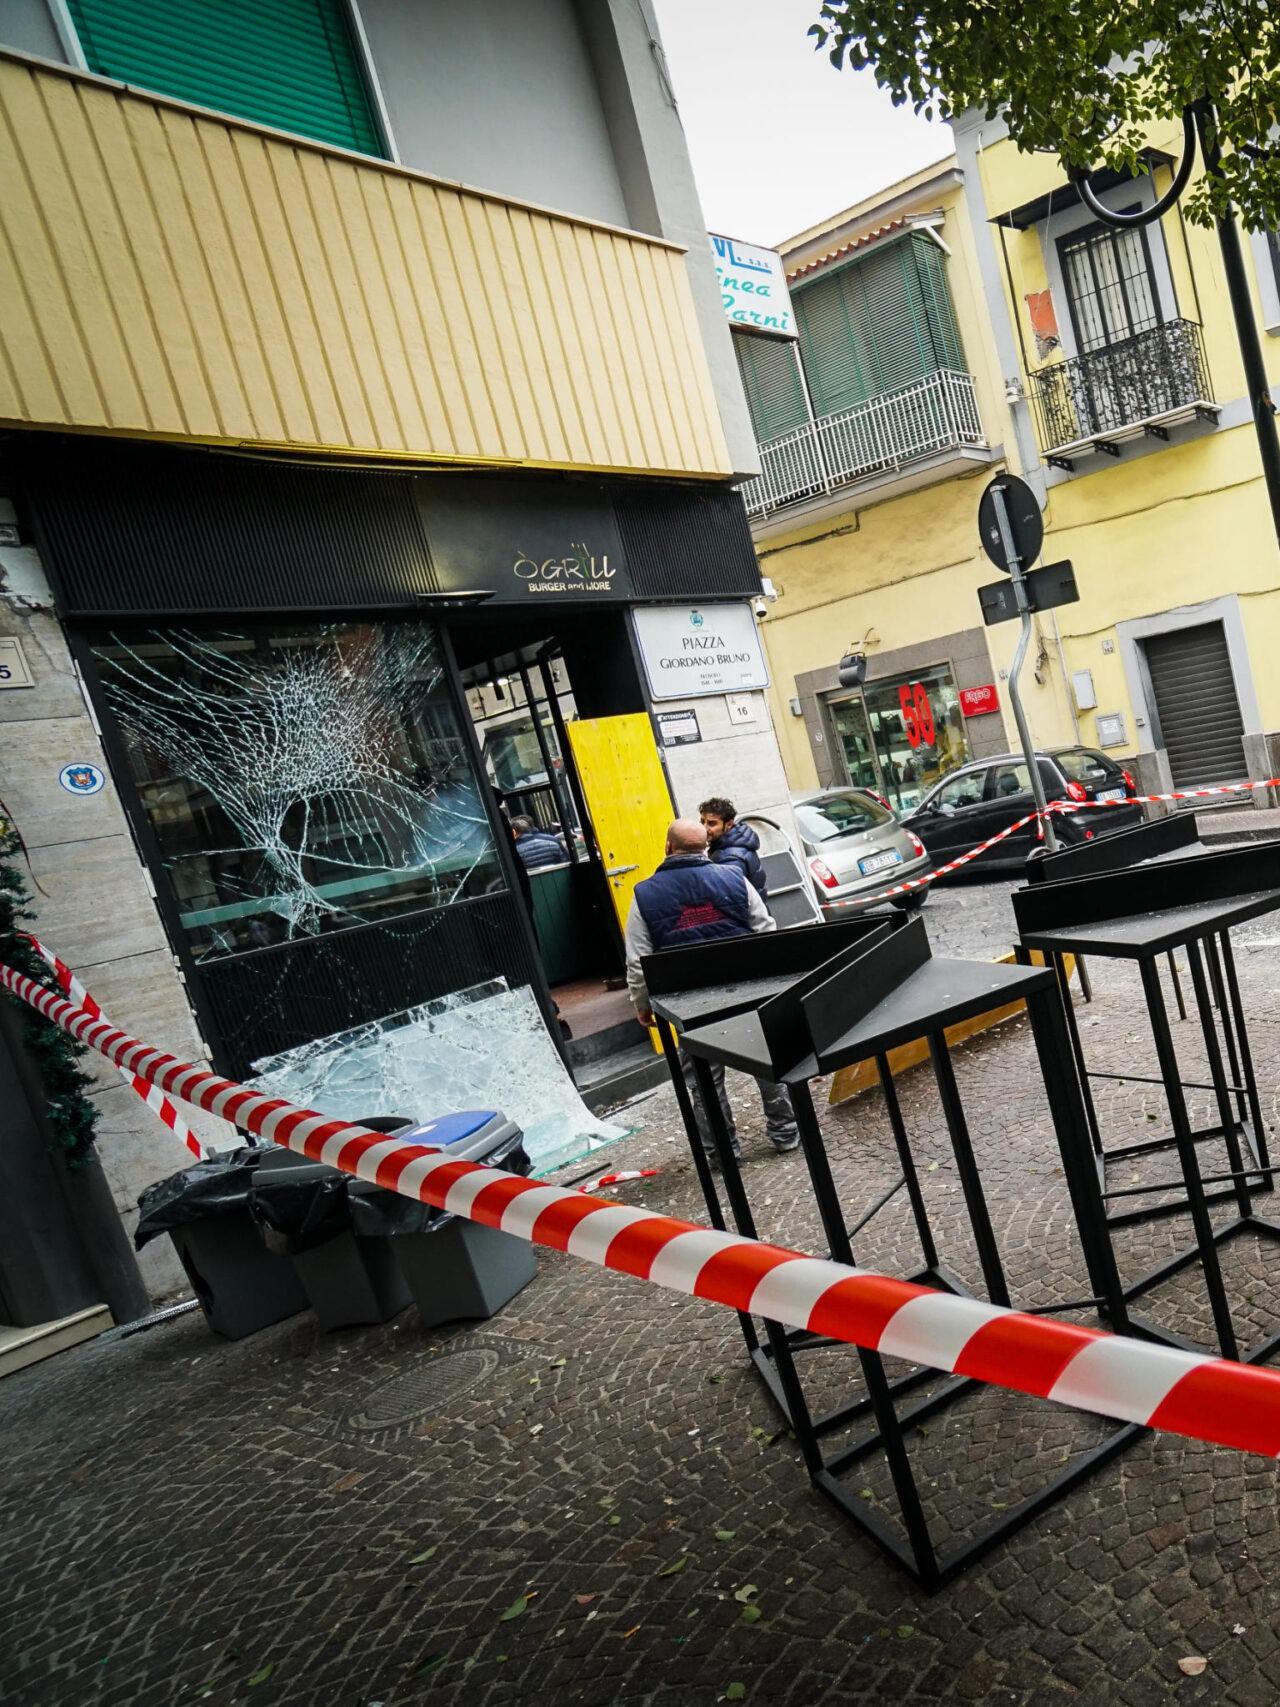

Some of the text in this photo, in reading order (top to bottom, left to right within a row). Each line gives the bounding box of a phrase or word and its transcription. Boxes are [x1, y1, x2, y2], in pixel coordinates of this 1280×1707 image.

[528, 582, 567, 592] BURGER
[585, 580, 612, 591] MORE
[682, 636, 726, 650] PIAZZA
[659, 652, 751, 670] GIORDANO BRUNO
[736, 705, 748, 716] 16
[898, 681, 936, 749] 50
